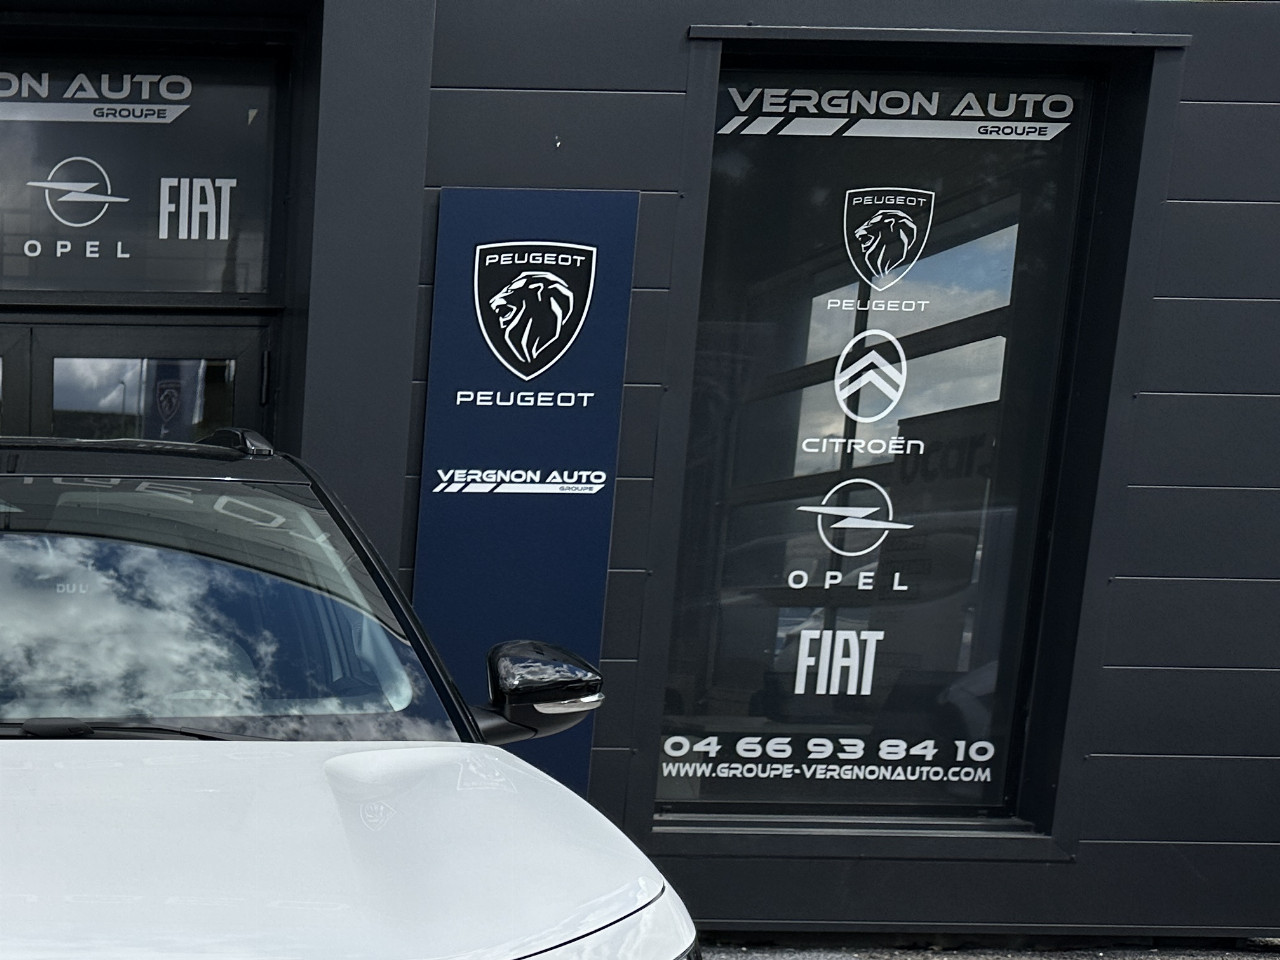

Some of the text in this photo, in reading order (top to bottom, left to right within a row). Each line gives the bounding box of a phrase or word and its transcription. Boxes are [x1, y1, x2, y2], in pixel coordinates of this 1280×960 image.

[63, 72, 193, 101] AUTO
[728, 88, 1074, 118] VERGNON AUTO
[93, 106, 167, 120] GROUPE
[977, 125, 1048, 137] GROUPE
[159, 177, 237, 240] FIAT
[852, 196, 927, 207] PEUGEOT
[23, 240, 131, 259] OPEL
[485, 253, 586, 267] PEUGEOT
[827, 299, 930, 313] PEUGEOT
[456, 391, 595, 407] PEUGEOT
[437, 469, 607, 484] VERGNON AUTO
[787, 570, 908, 591] OPEL
[794, 630, 885, 696] FIAT
[663, 736, 995, 762] 04 66 93 84 10
[661, 763, 991, 783] WWW.GROUPE-VERGNONAUTO.COM
